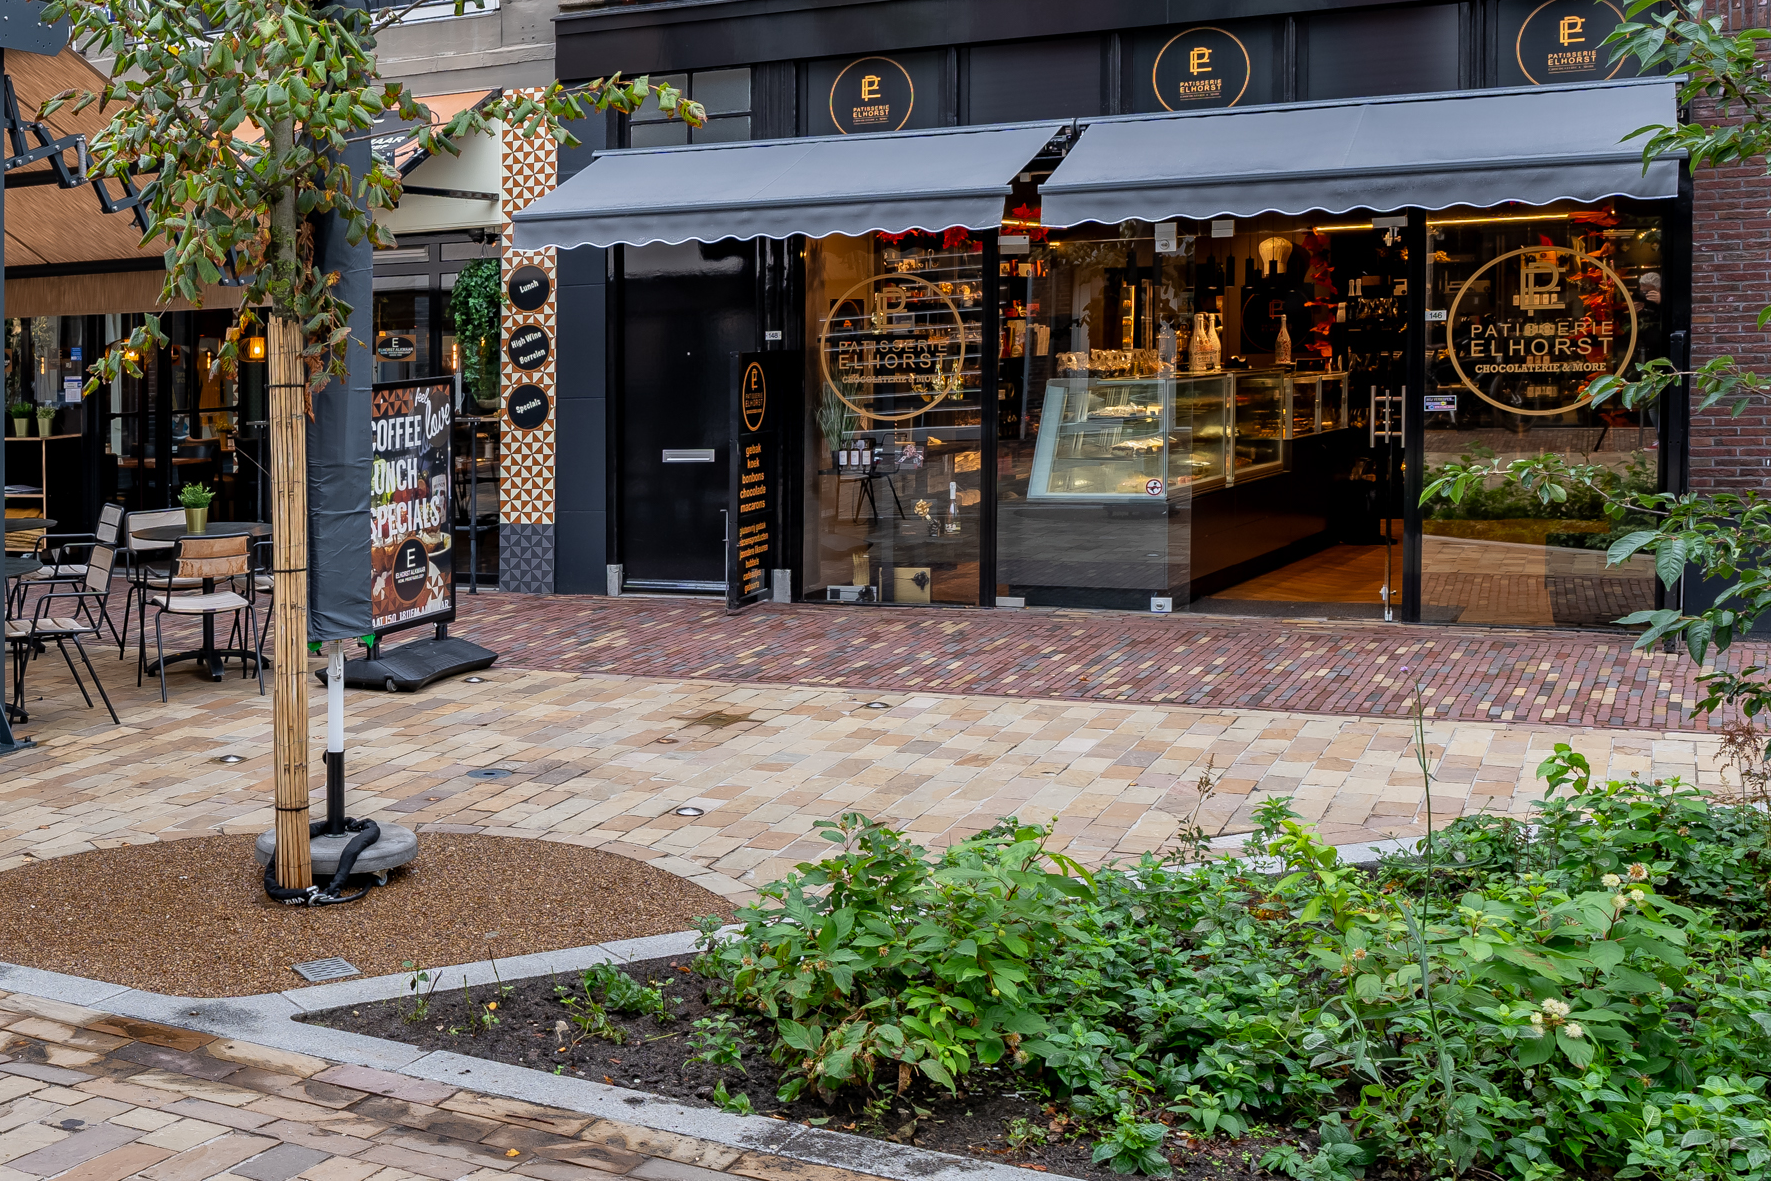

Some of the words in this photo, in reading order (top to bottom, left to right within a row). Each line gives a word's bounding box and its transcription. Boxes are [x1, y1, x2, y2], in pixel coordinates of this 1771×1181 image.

[1548, 50, 1597, 59] PATISSERIE
[1548, 56, 1596, 65] ELHORST
[1180, 79, 1222, 87] PATISSERIE
[1180, 85, 1221, 93] ELHORST
[519, 279, 539, 293] Lunch
[1471, 321, 1613, 337] PATISSERIE
[511, 336, 526, 349] High
[525, 331, 542, 344] Wine
[839, 339, 947, 353] PATISSERIE
[1471, 337, 1613, 357] ELHORST
[519, 348, 546, 364] Borrelen
[839, 352, 947, 369] ELHORST
[1475, 363, 1560, 373] CHOCOLATERIE
[1562, 363, 1571, 372] &
[1572, 362, 1607, 372] MORE
[414, 387, 430, 407] feel
[515, 398, 541, 414] Specials
[425, 400, 450, 439] love
[746, 443, 761, 457] gebak
[747, 457, 760, 469] koek
[371, 458, 418, 496] UNCH
[742, 472, 764, 484] bonbons
[740, 484, 766, 499] chocolade
[740, 500, 765, 513] macarons
[407, 548, 416, 568] E
